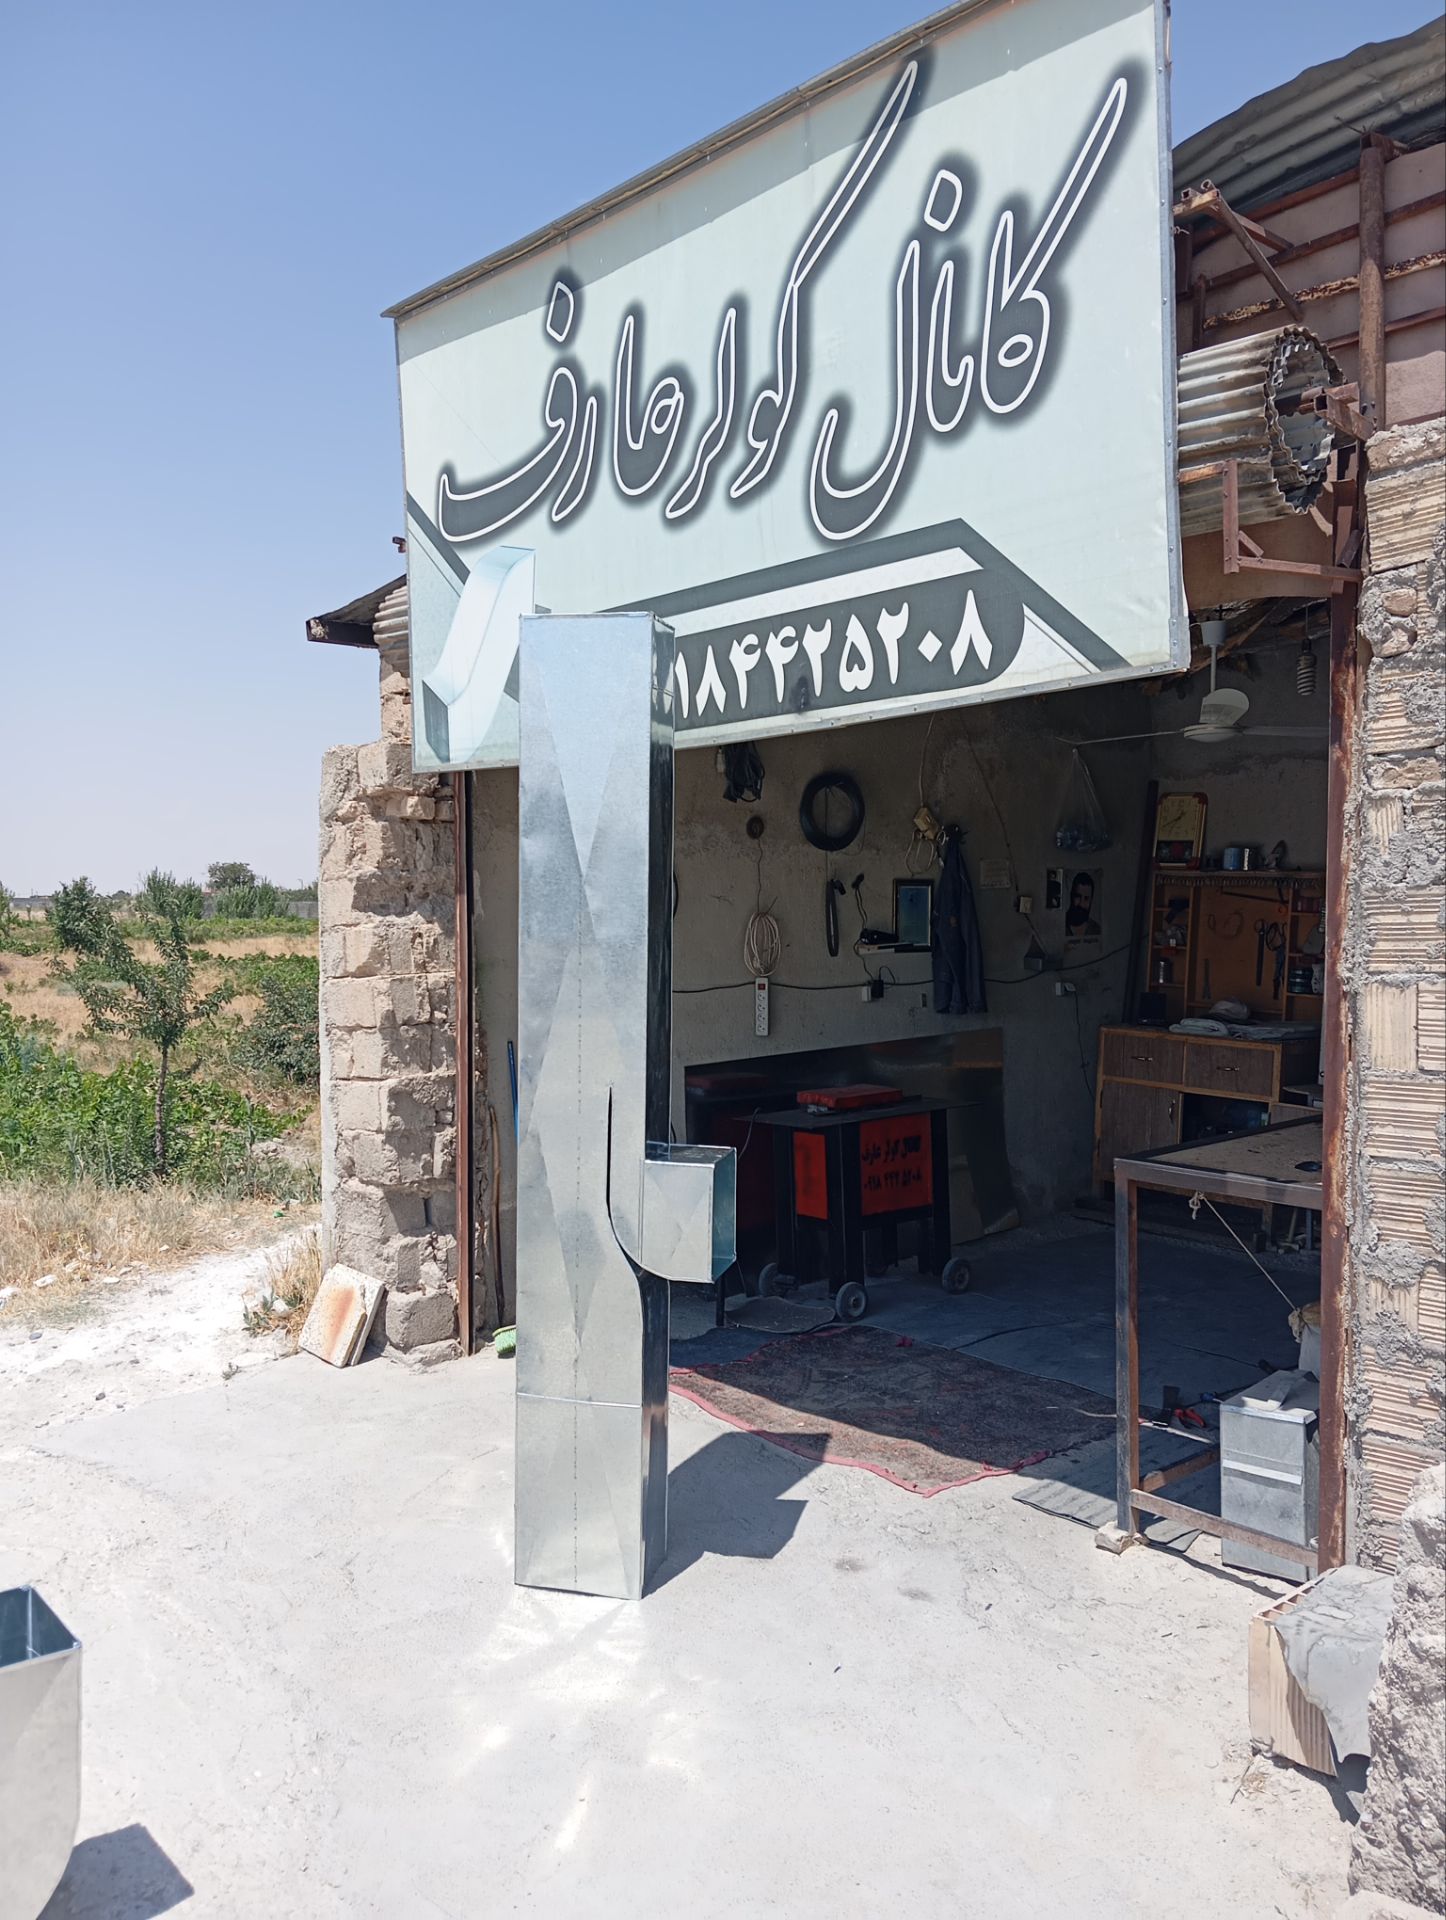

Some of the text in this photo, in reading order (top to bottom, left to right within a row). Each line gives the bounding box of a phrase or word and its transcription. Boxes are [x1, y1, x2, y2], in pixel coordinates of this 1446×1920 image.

[438, 60, 1129, 542] کانال کولر عارف
